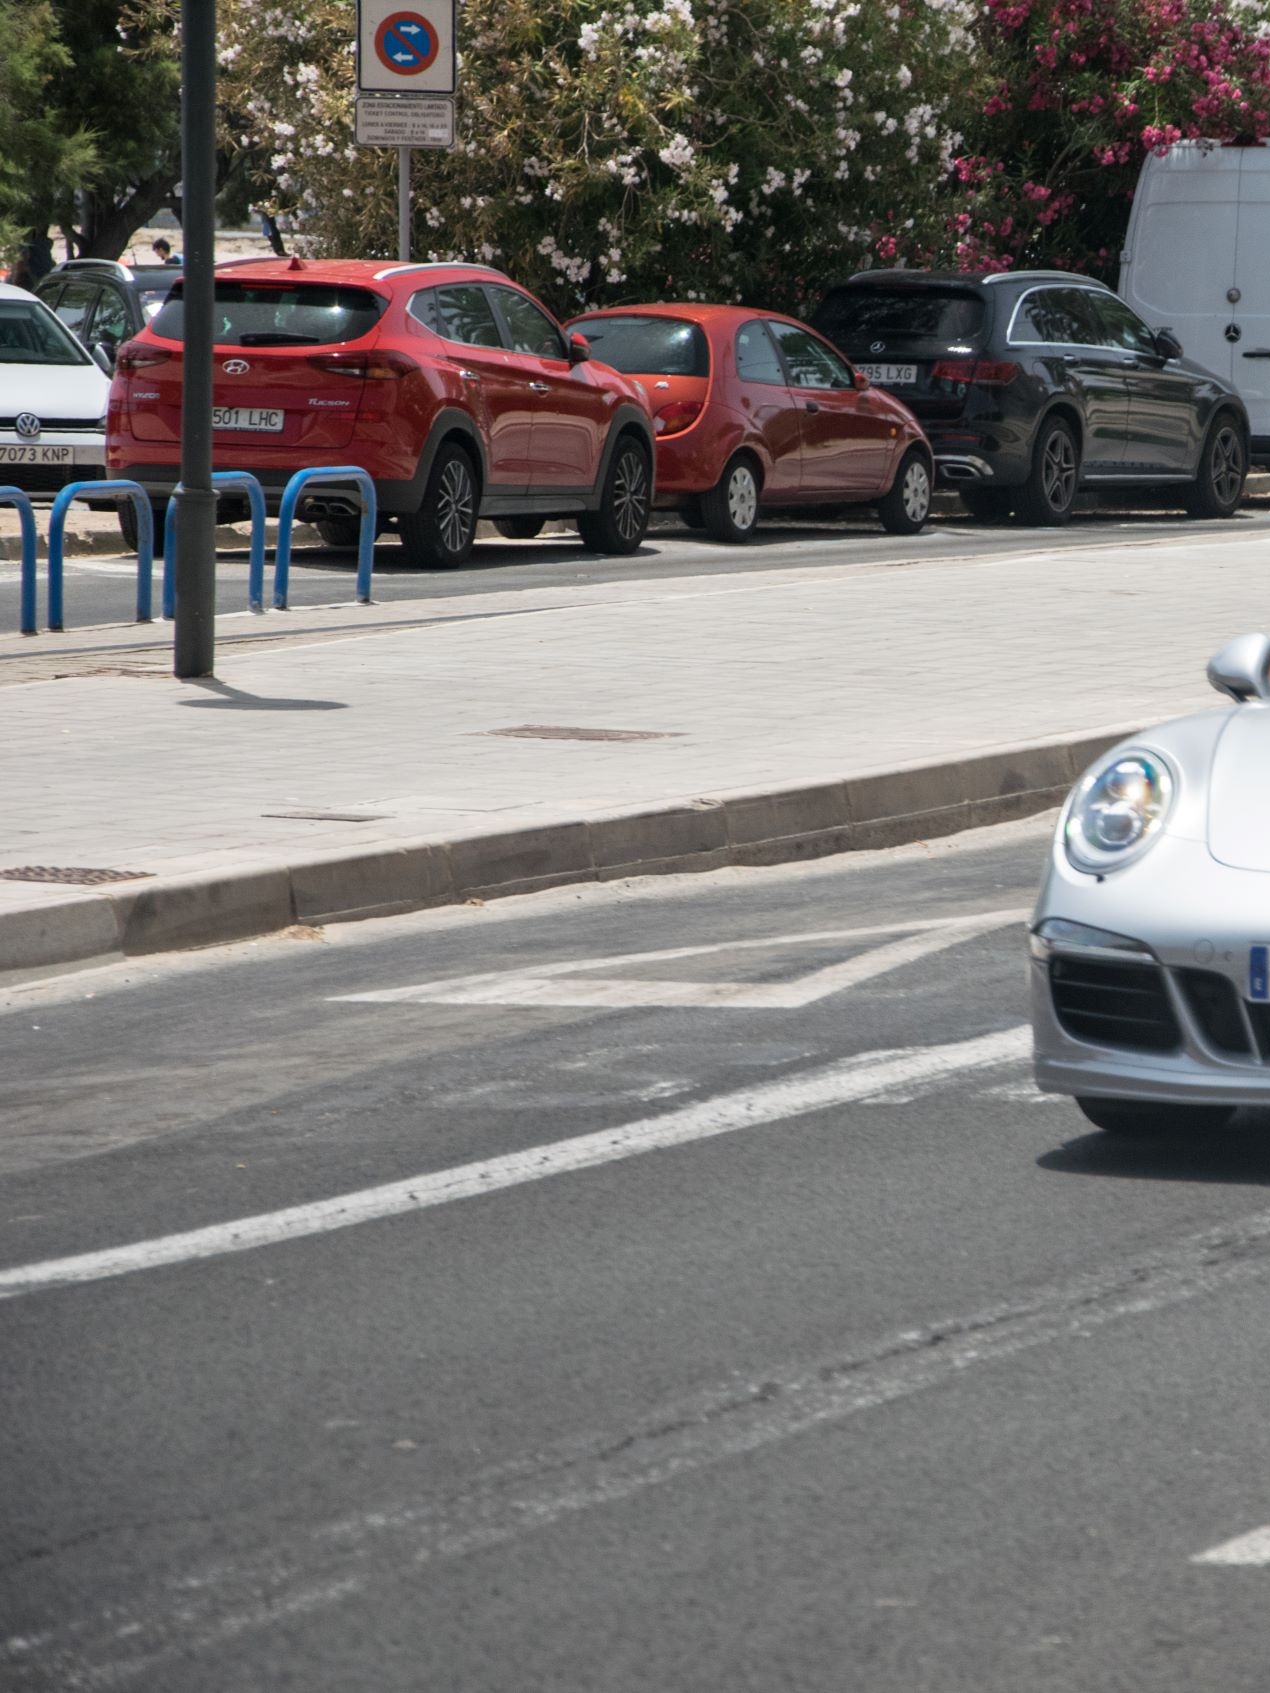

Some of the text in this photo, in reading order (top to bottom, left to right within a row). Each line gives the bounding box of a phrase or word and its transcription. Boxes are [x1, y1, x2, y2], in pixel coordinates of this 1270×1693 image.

[858, 366, 912, 380] 795 LXG
[213, 411, 279, 427] 501 LHC
[0, 447, 69, 462] 7073 KNP
